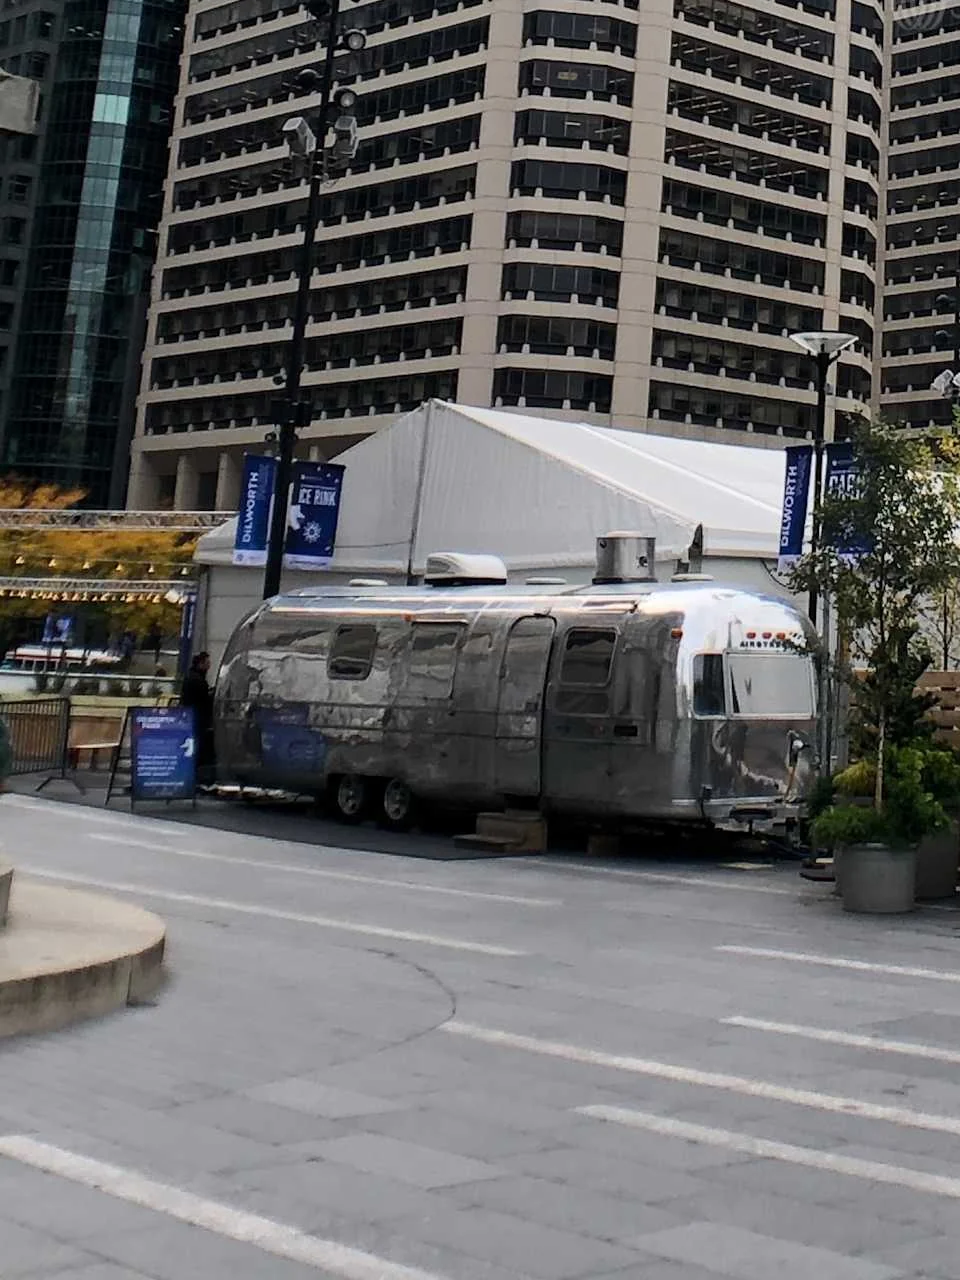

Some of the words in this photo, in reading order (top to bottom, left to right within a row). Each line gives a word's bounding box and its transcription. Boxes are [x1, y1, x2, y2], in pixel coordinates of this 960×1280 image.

[242, 472, 259, 543] DILWORTH
[298, 488, 313, 505] ICE
[313, 489, 336, 507] RINK
[781, 466, 798, 547] DILWORTH
